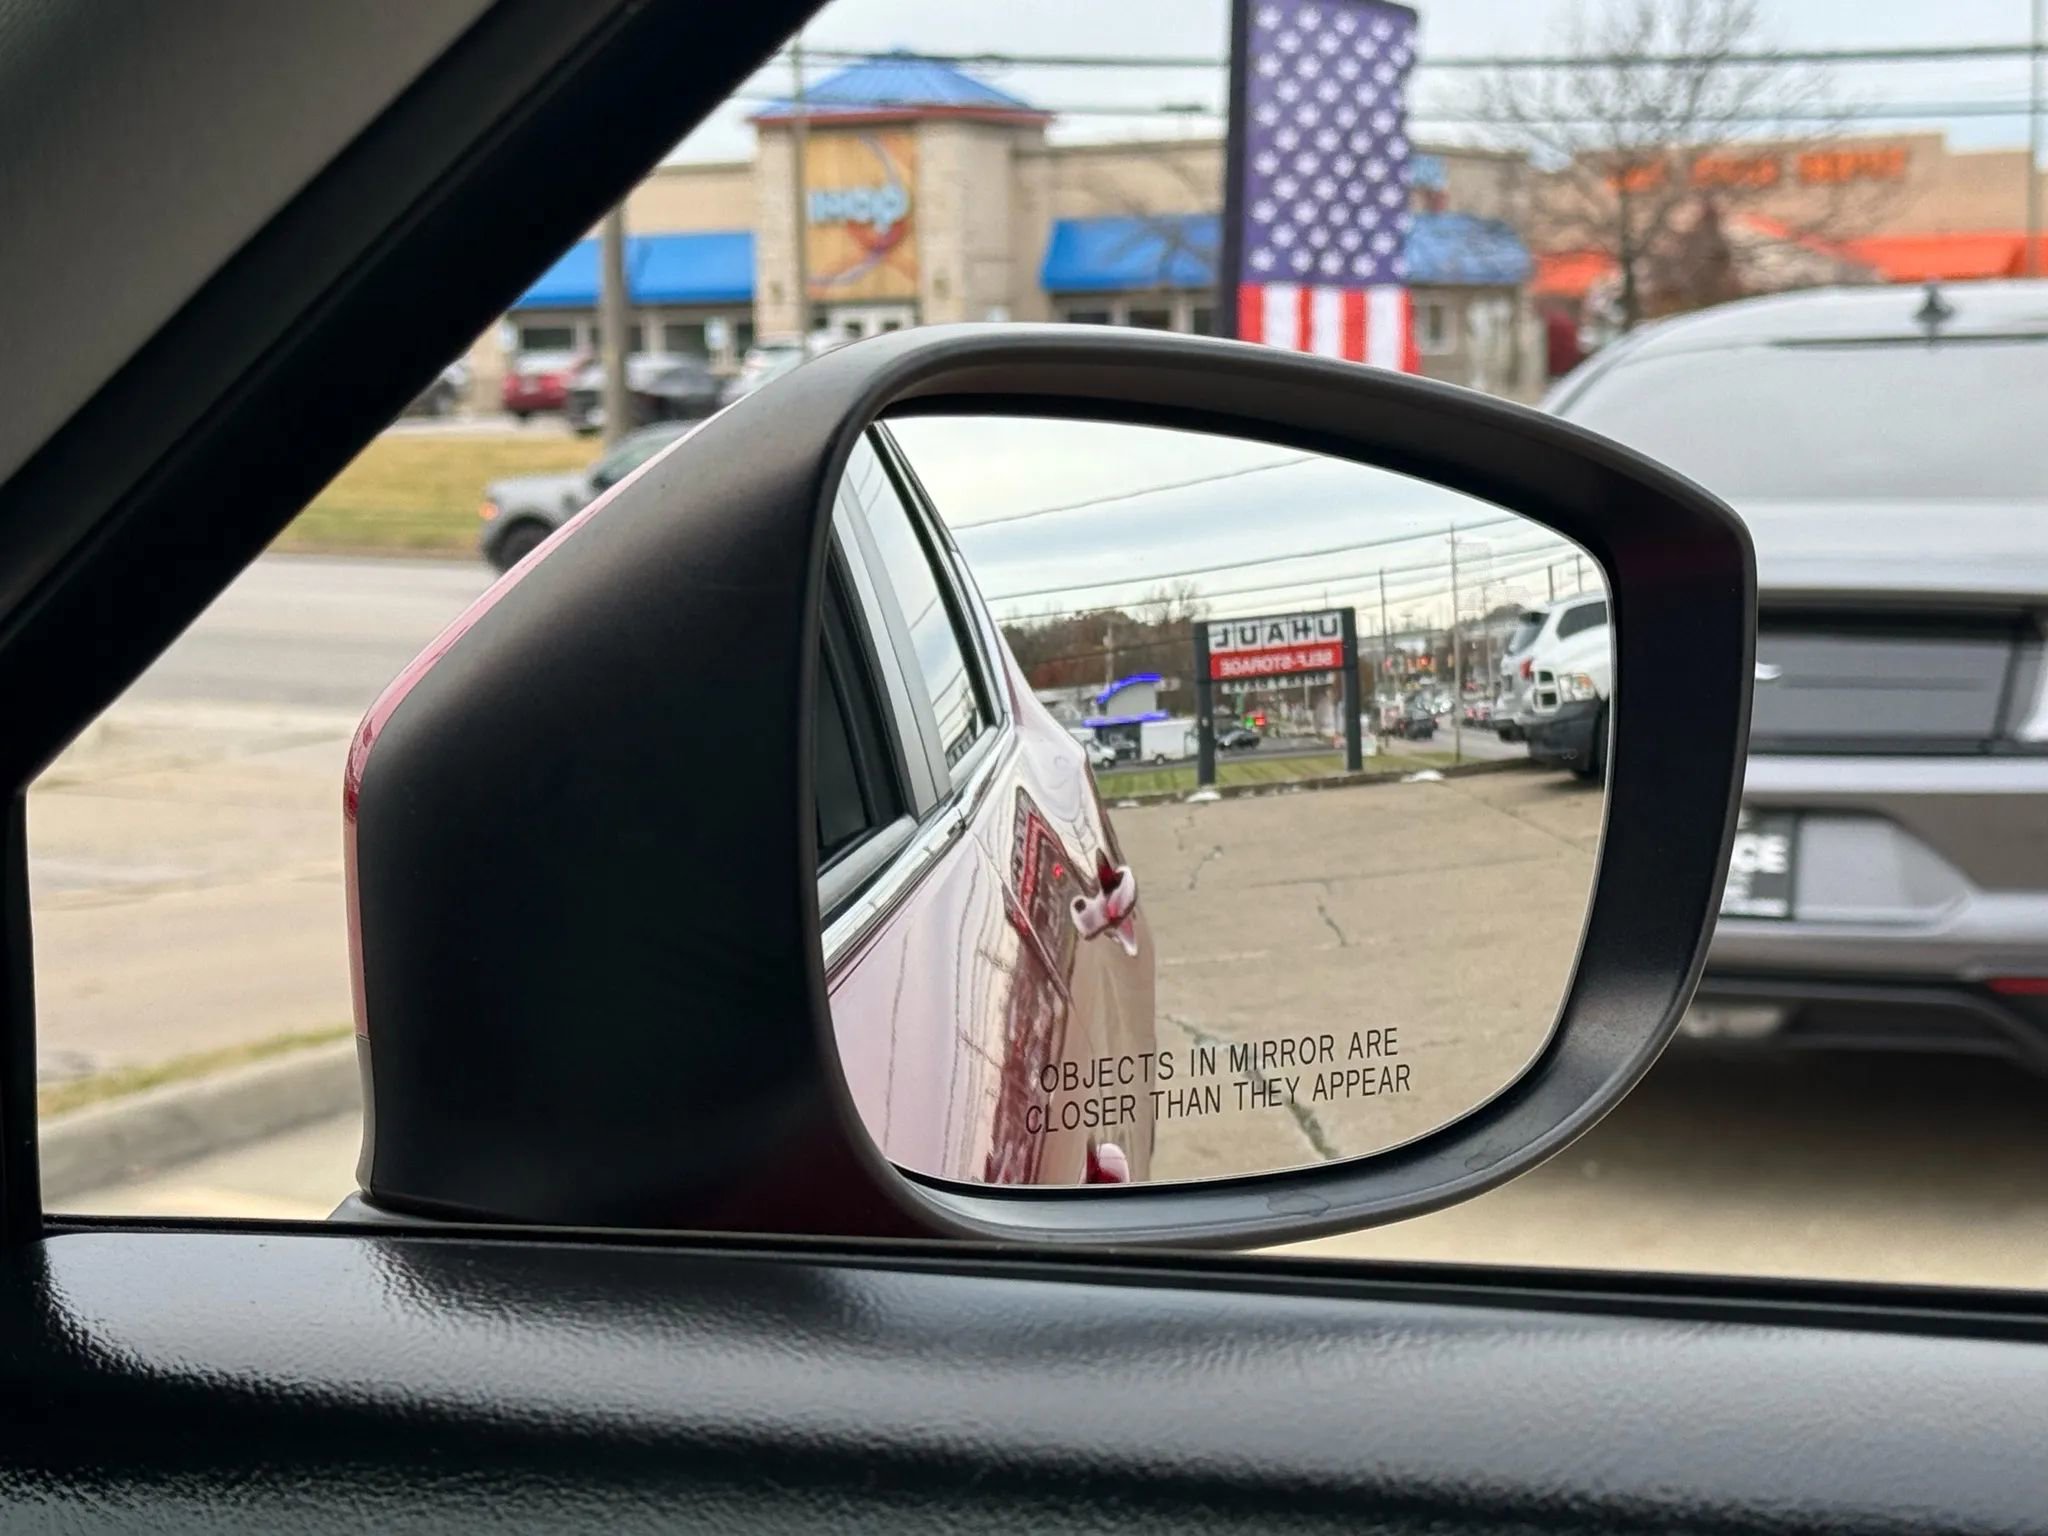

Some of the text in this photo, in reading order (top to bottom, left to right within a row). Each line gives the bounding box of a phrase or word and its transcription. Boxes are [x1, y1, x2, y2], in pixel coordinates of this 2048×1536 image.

[1040, 1027, 1399, 1093] OBJECTS IN MIRROR ARE
[1025, 1064, 1411, 1135] CLOSER THAN THEY APPEAR
